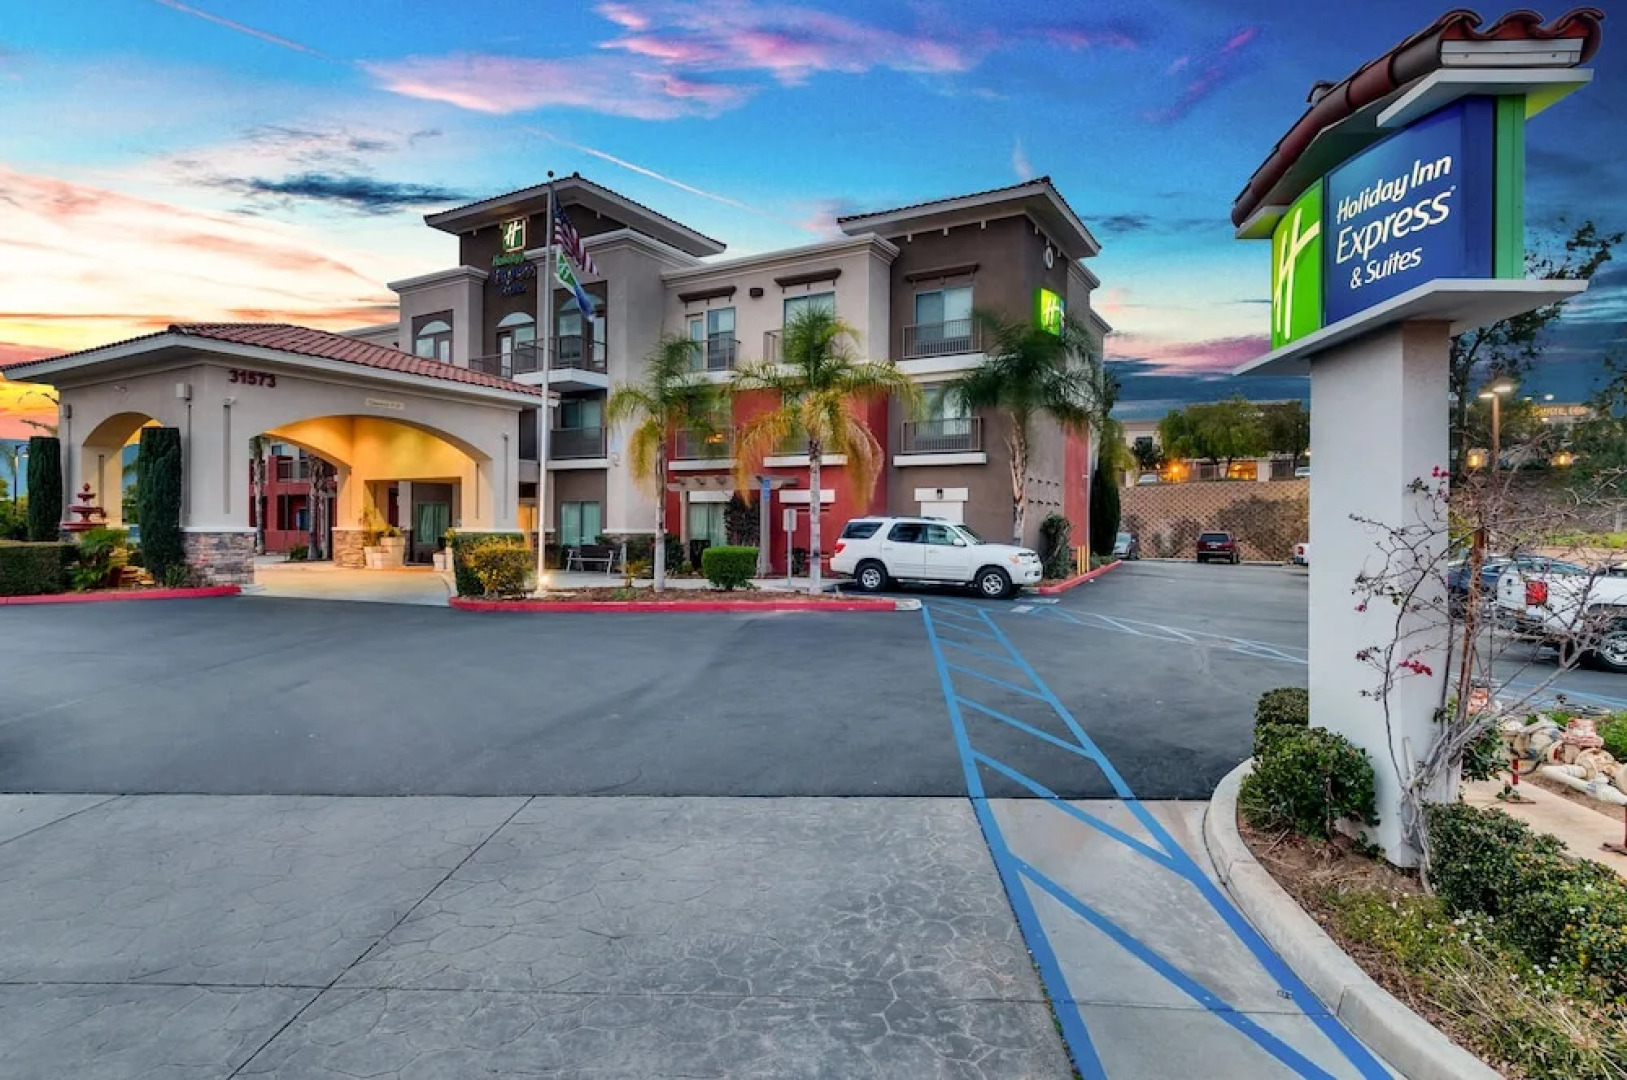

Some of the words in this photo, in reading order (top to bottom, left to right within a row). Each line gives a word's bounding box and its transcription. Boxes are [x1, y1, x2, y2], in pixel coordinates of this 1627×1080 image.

[1336, 174, 1409, 225] Holiday
[1411, 155, 1452, 188] Inn
[1336, 191, 1451, 264] Express
[1350, 266, 1362, 289] &
[1365, 247, 1422, 284] Suites
[228, 368, 276, 388] 31573
